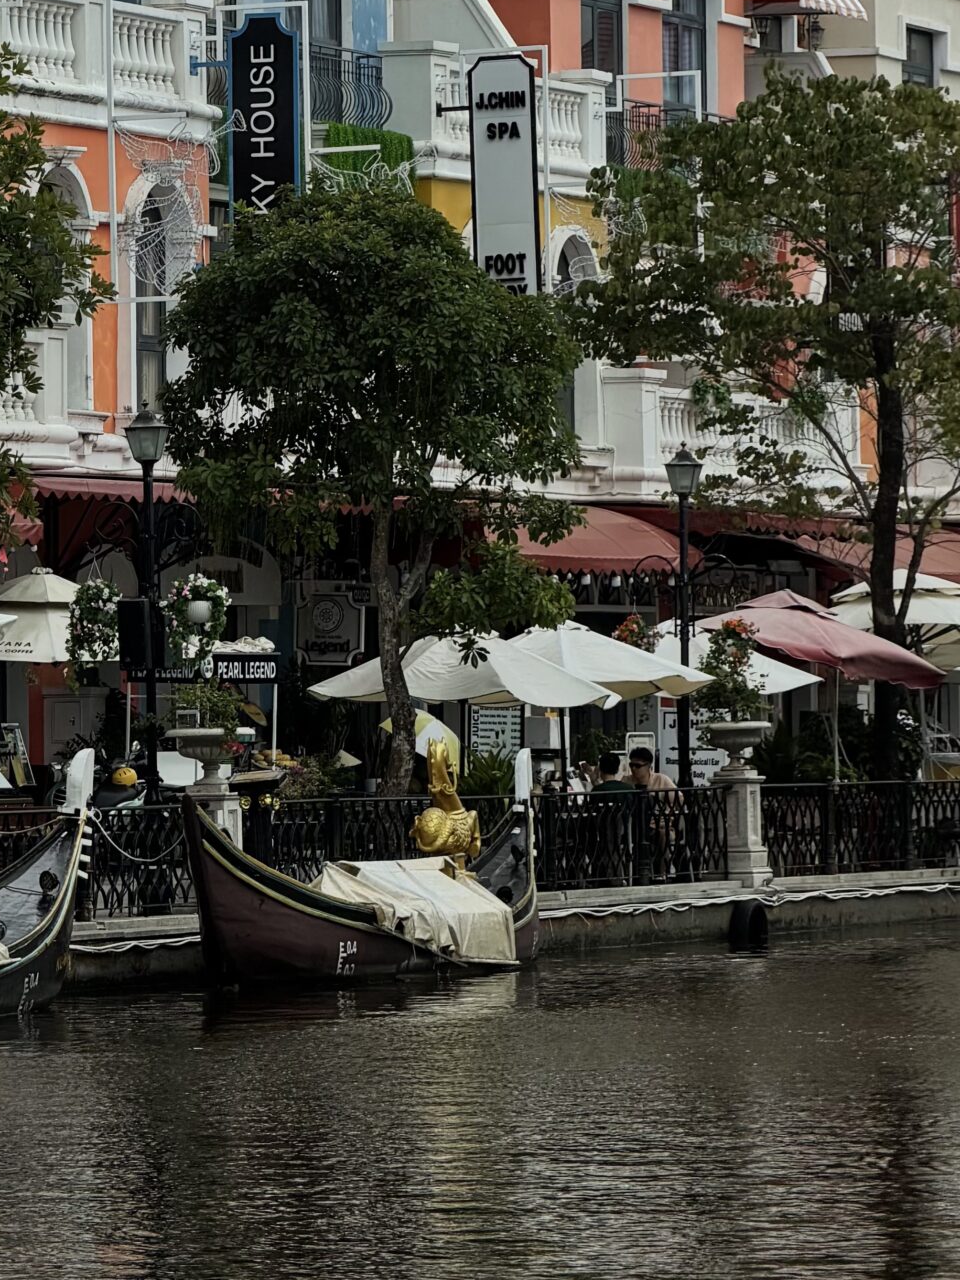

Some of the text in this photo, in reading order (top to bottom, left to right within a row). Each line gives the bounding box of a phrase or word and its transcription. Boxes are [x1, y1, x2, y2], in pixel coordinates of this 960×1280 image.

[250, 43, 276, 158] HOUSE
[475, 90, 527, 111] J.CHIN
[487, 122, 521, 141] SPA
[485, 252, 527, 276] FOOT
[305, 639, 350, 655] Legend
[218, 661, 277, 679] PEARL LEGEND
[472, 708, 480, 739] JUICE
